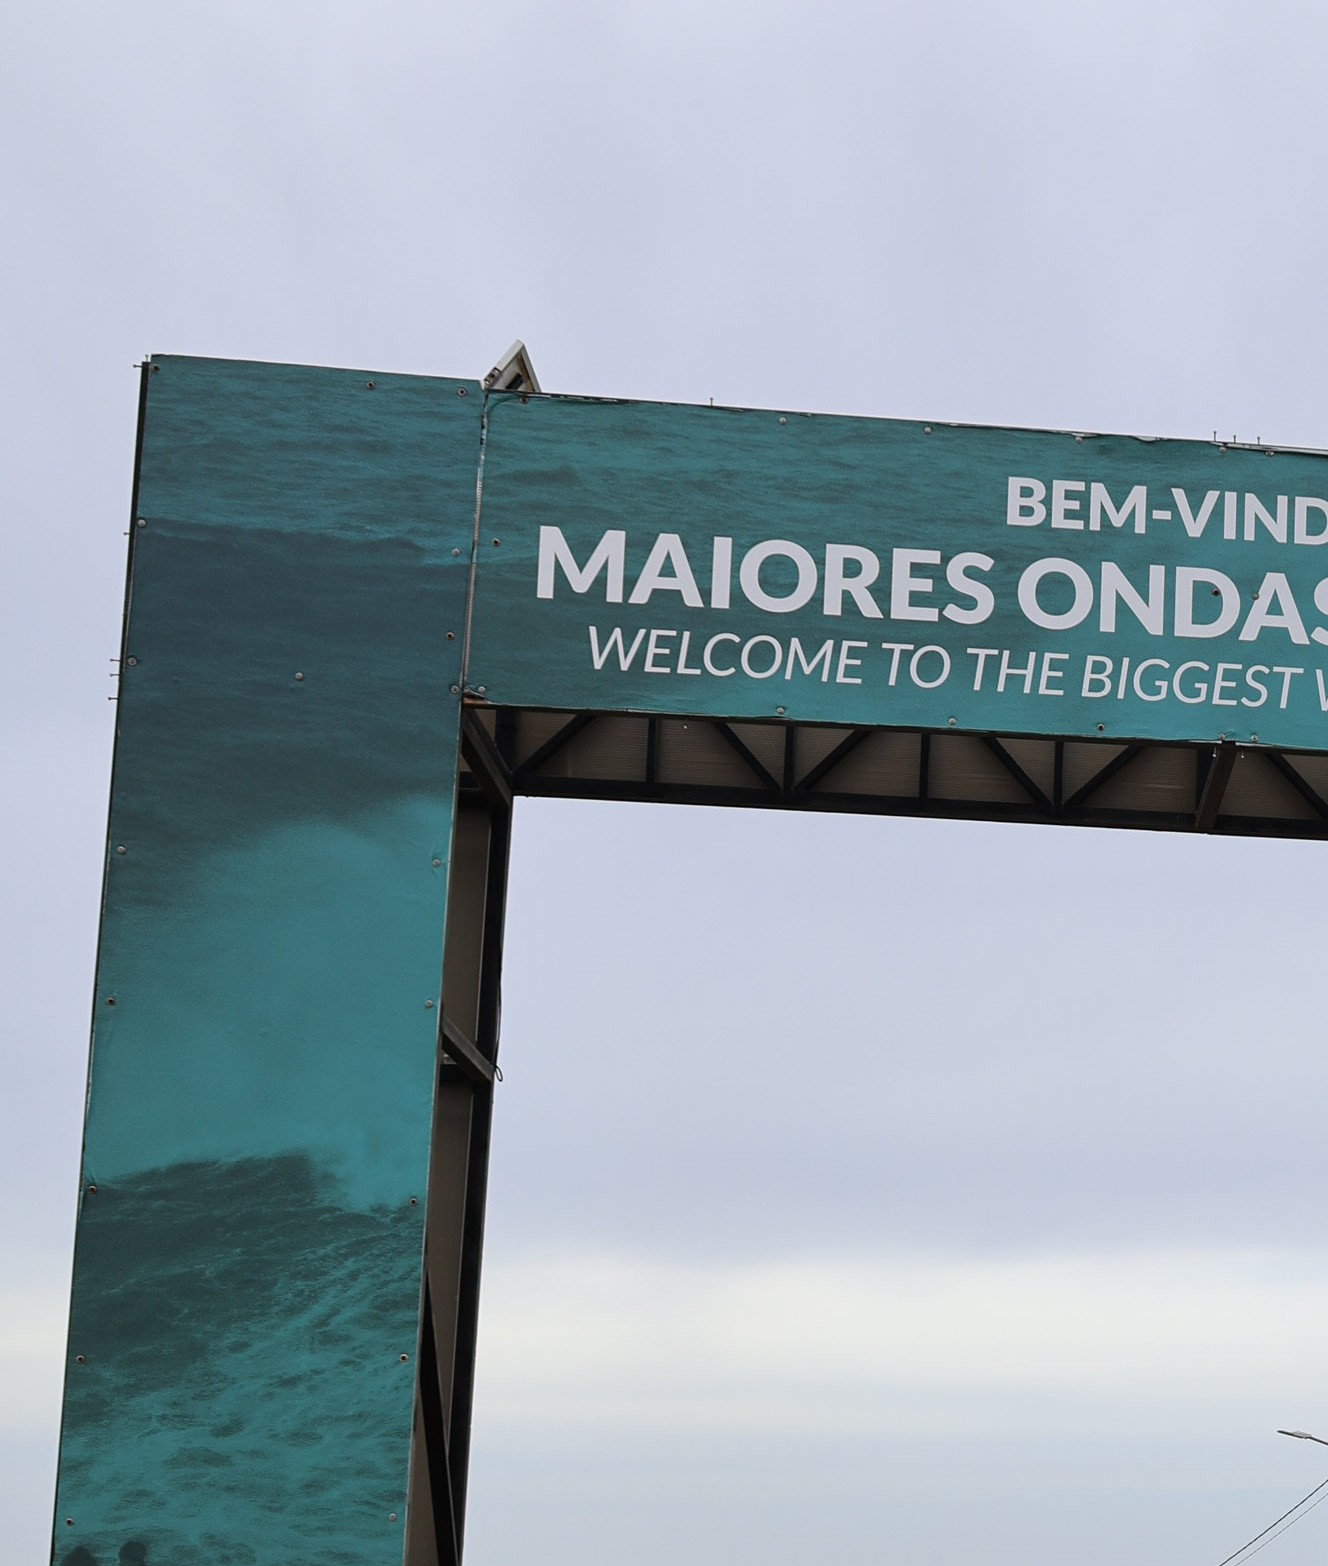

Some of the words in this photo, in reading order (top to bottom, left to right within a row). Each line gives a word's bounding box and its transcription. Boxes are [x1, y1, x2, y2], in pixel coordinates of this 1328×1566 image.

[536, 525, 996, 626] MAIORES
[587, 625, 869, 685] WELCOME
[881, 642, 952, 689] TO
[966, 647, 1070, 697] THE
[1081, 655, 1304, 710] BIGGEST
